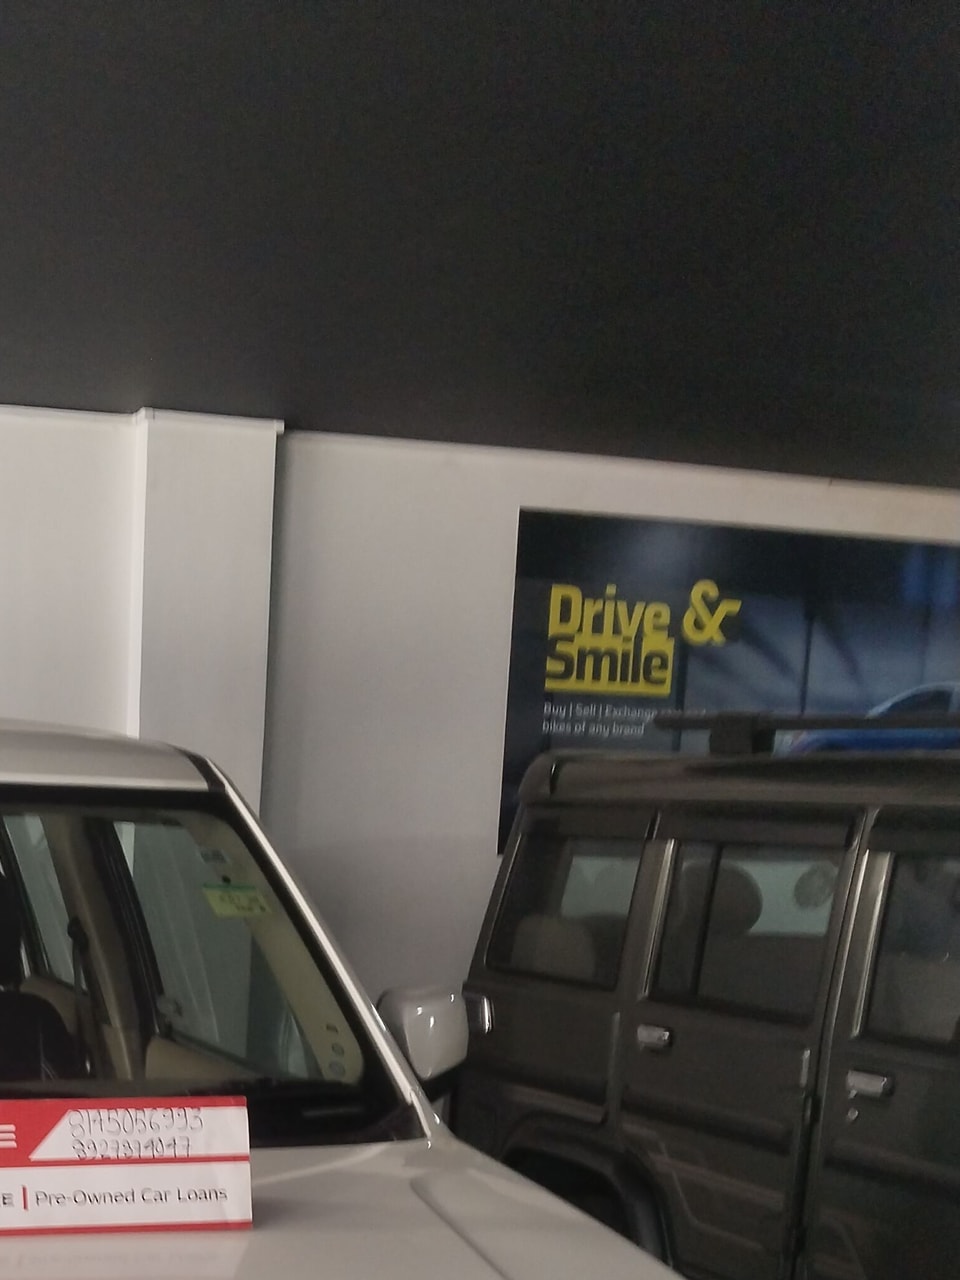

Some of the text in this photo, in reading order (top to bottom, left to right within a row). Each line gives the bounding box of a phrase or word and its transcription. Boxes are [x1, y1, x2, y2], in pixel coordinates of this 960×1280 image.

[548, 578, 742, 647] Drive &
[545, 637, 670, 686] Smile
[542, 701, 567, 719] Buy
[575, 702, 597, 717] Sell
[542, 719, 646, 737] bikes of any brand
[34, 1187, 136, 1207] Pre-Owned
[141, 1186, 171, 1204] Car
[176, 1186, 229, 1204] Loans
